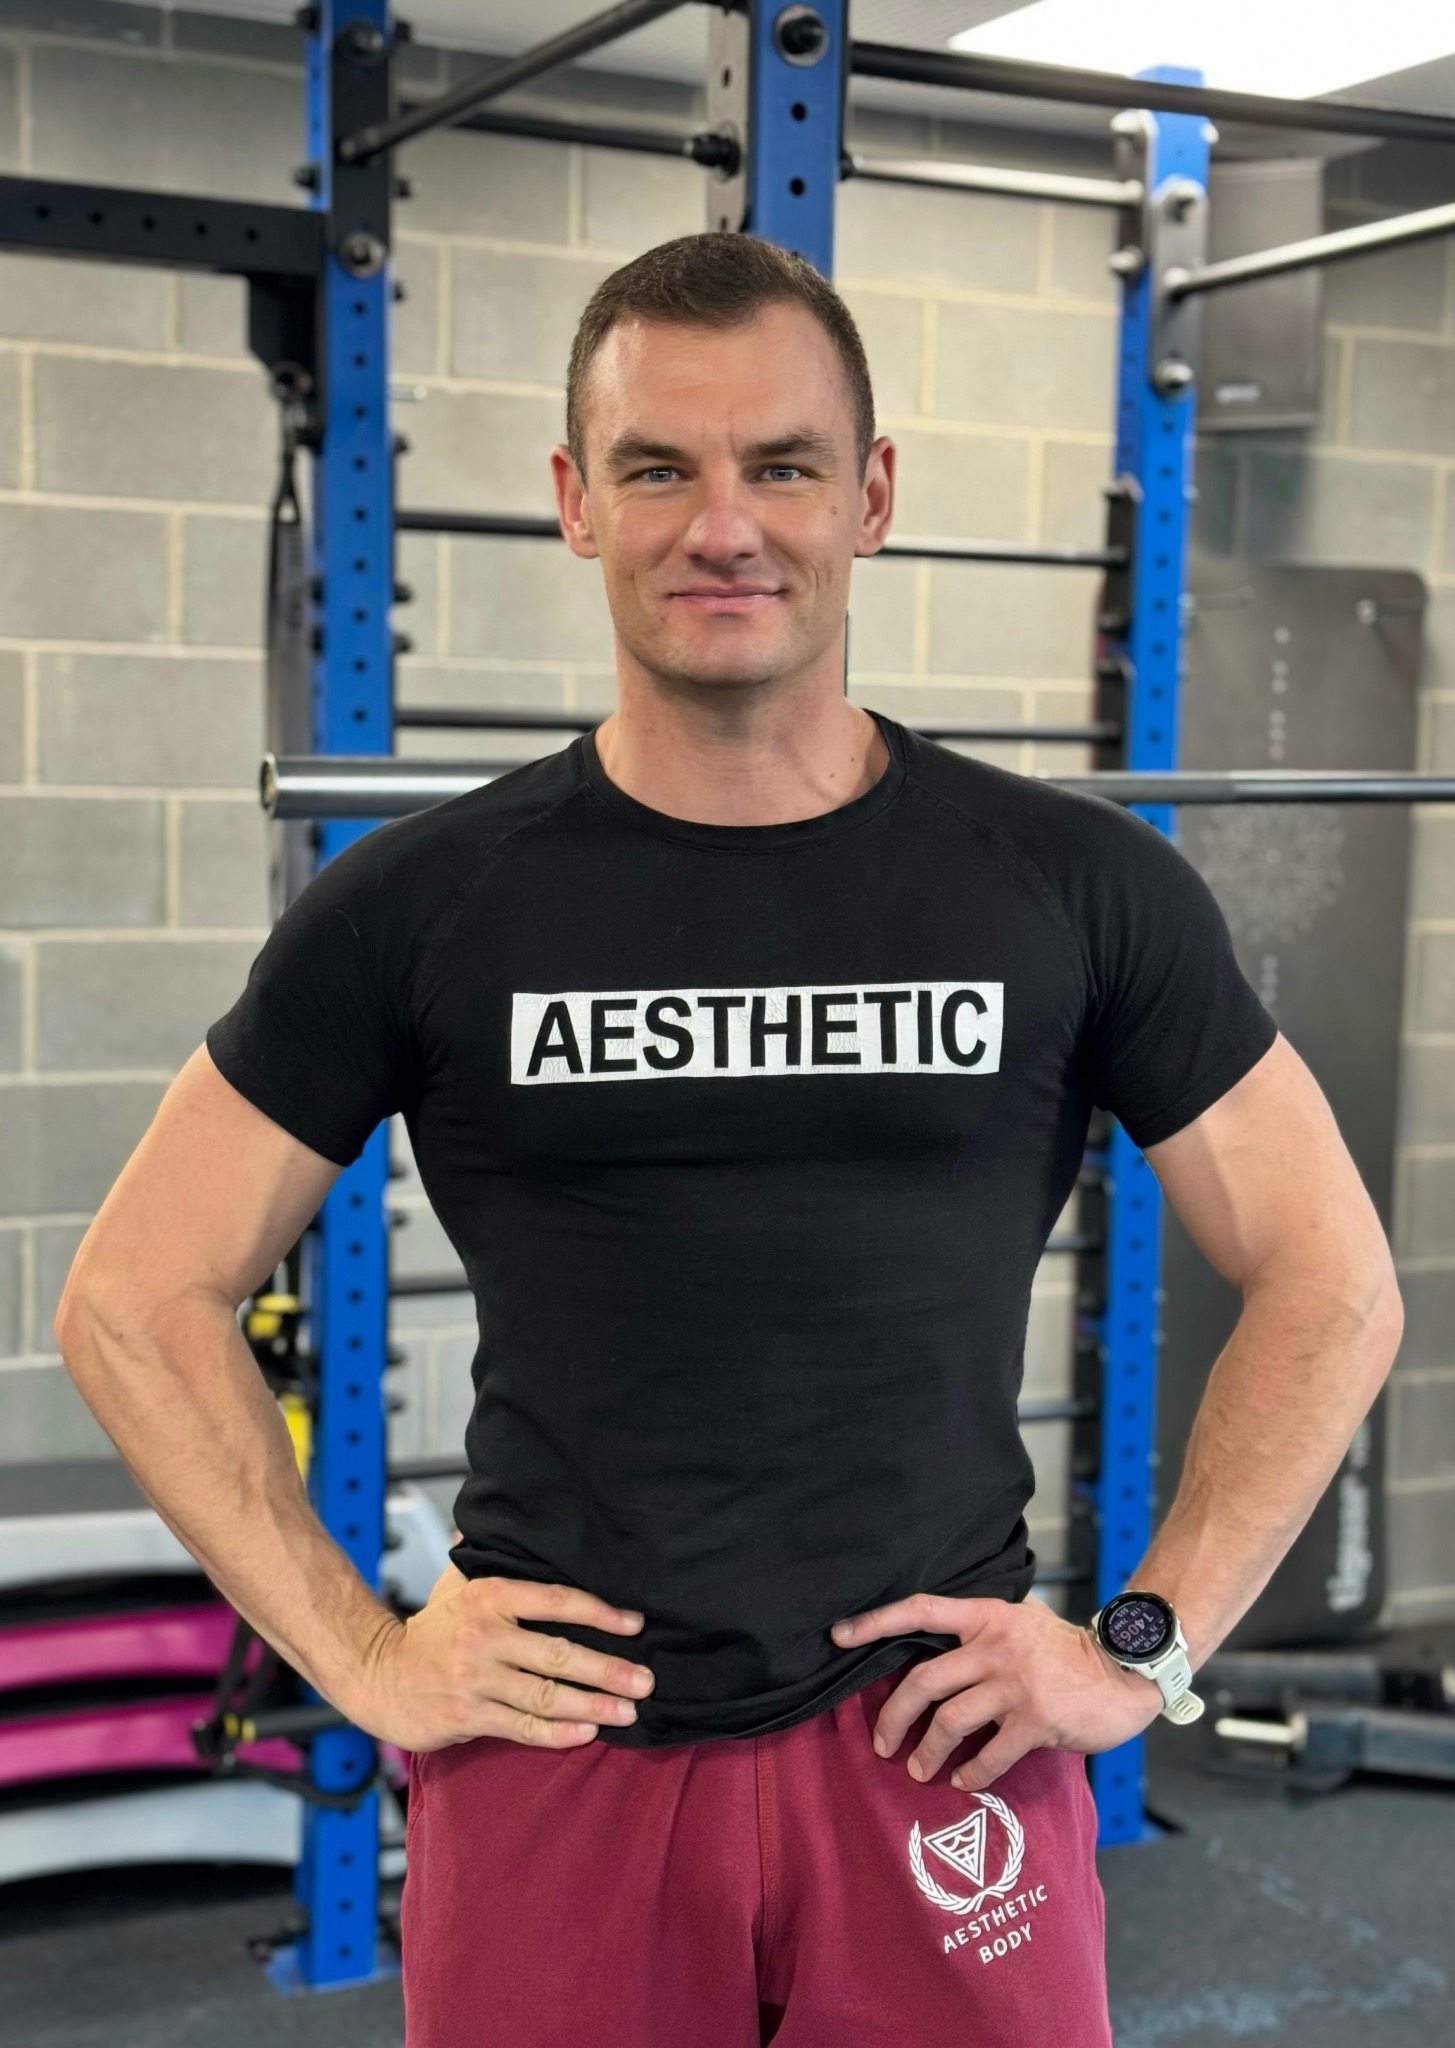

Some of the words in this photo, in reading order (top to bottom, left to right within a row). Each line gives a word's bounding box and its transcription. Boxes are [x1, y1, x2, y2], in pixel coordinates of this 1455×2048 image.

[526, 988, 989, 1077] AESTHETIC
[1119, 1612, 1154, 1642] 1406
[942, 1885, 1048, 1954] AESTHETIC
[978, 1922, 1033, 1964] BODY
